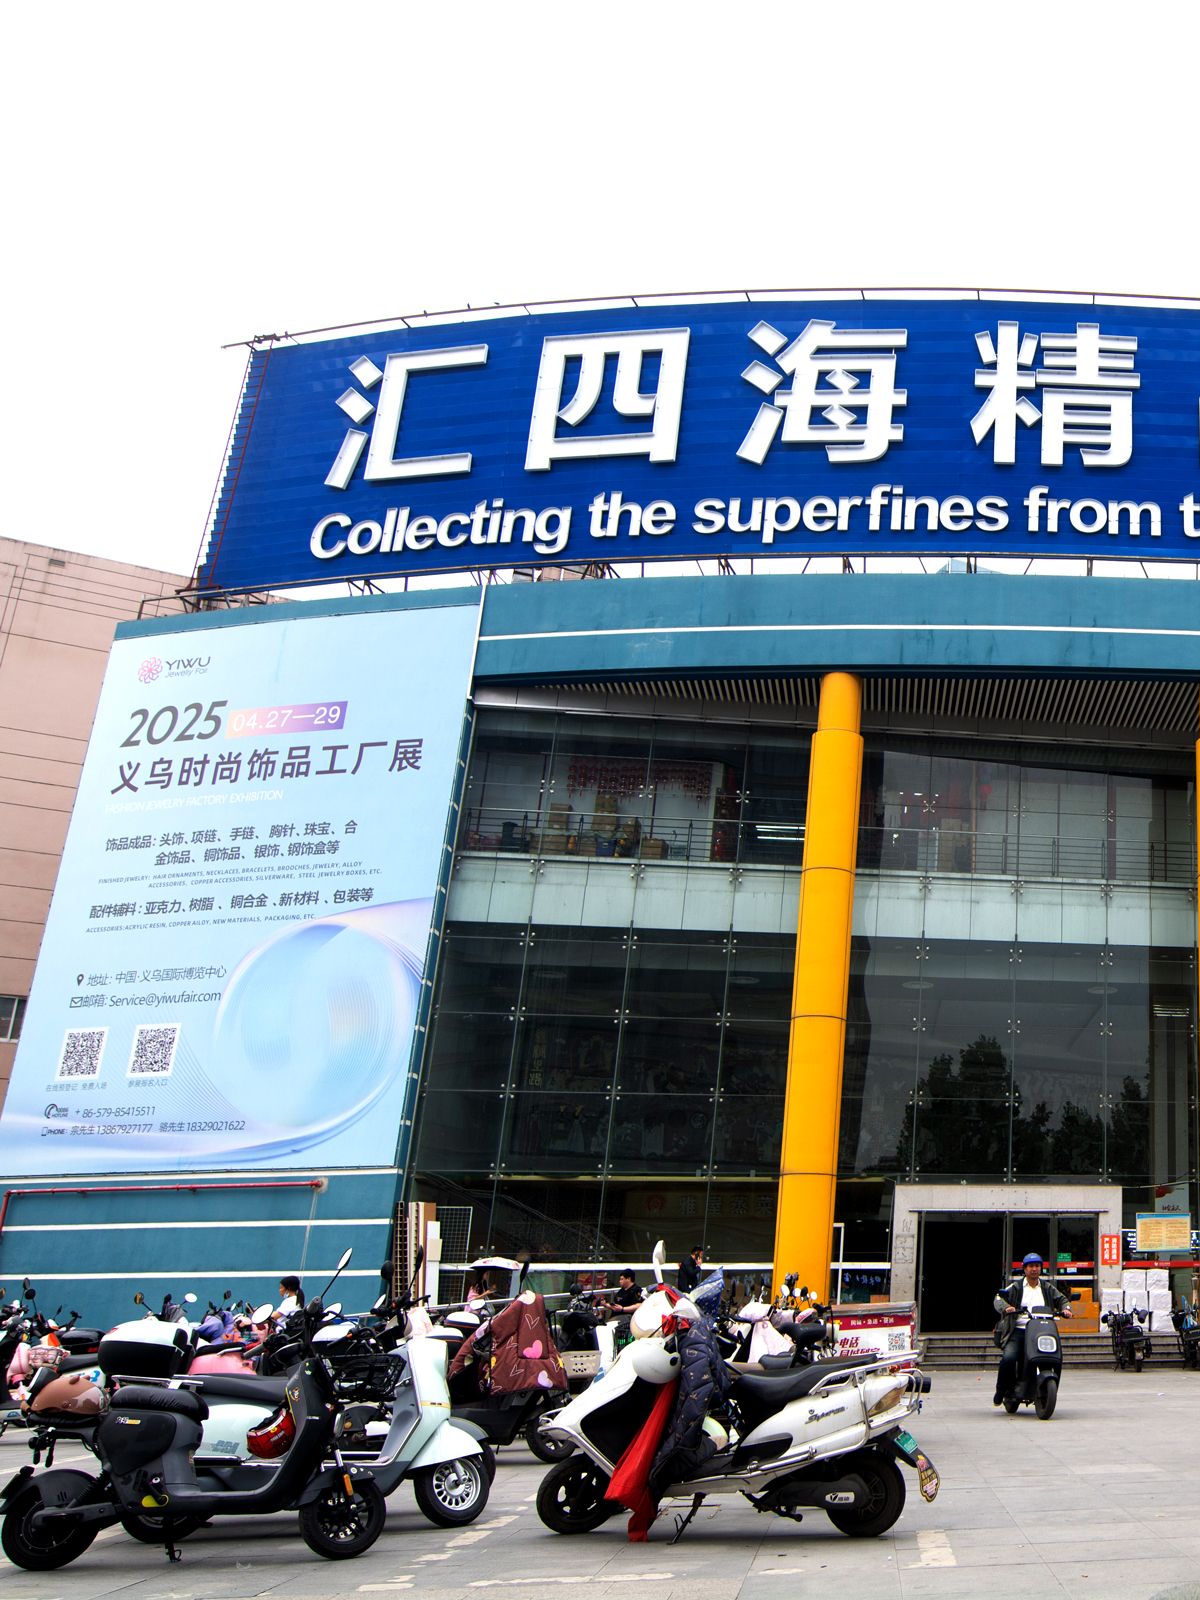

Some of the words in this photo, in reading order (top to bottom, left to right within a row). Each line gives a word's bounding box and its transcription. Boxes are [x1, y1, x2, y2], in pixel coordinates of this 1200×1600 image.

[309, 498, 572, 560] Collecting
[588, 491, 677, 538] the
[1024, 486, 1162, 537] from
[165, 655, 211, 671] YIWU
[119, 700, 229, 748] 2025
[111, 738, 424, 795] 义乌时尚饰品工厂展
[186, 794, 227, 808] FACTORY
[229, 789, 285, 804] EXHIBITION
[190, 878, 214, 886] COPPER
[298, 871, 316, 879] STEEL
[168, 920, 191, 928] COPPER
[109, 990, 221, 1008] Service@yiwufair.com
[96, 1123, 153, 1136] 13867927177
[186, 1120, 247, 1132] 18329021622
[839, 1336, 861, 1349] 电话
